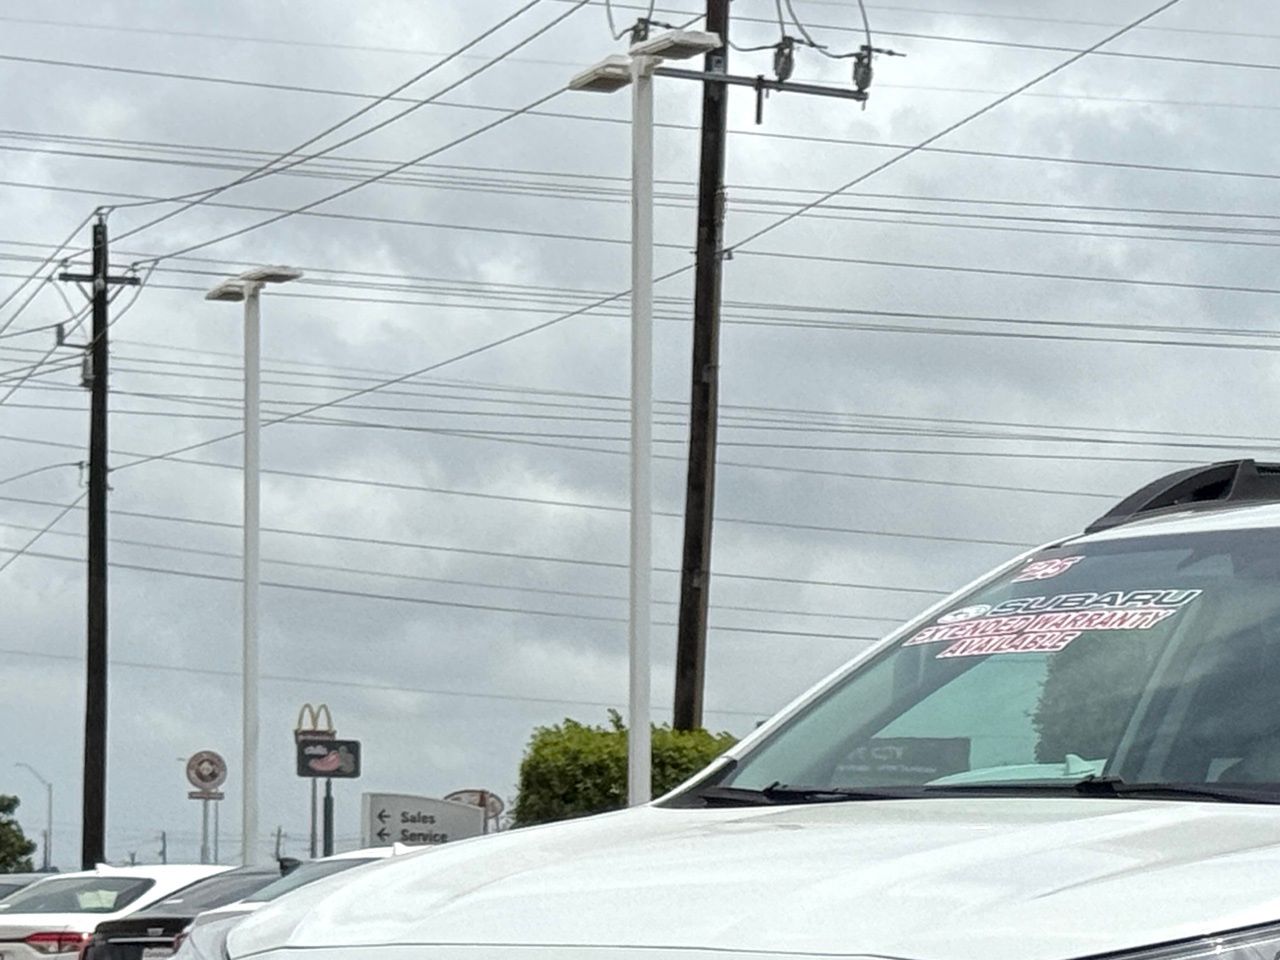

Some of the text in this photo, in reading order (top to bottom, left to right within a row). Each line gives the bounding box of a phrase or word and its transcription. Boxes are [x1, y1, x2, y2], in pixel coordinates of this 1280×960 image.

[987, 589, 1202, 616] SUBARU
[903, 609, 1177, 646] EXTENDED WARRANTY
[936, 631, 1082, 658] AVAILABLE
[400, 811, 436, 824] Sales
[400, 829, 448, 843] Service
